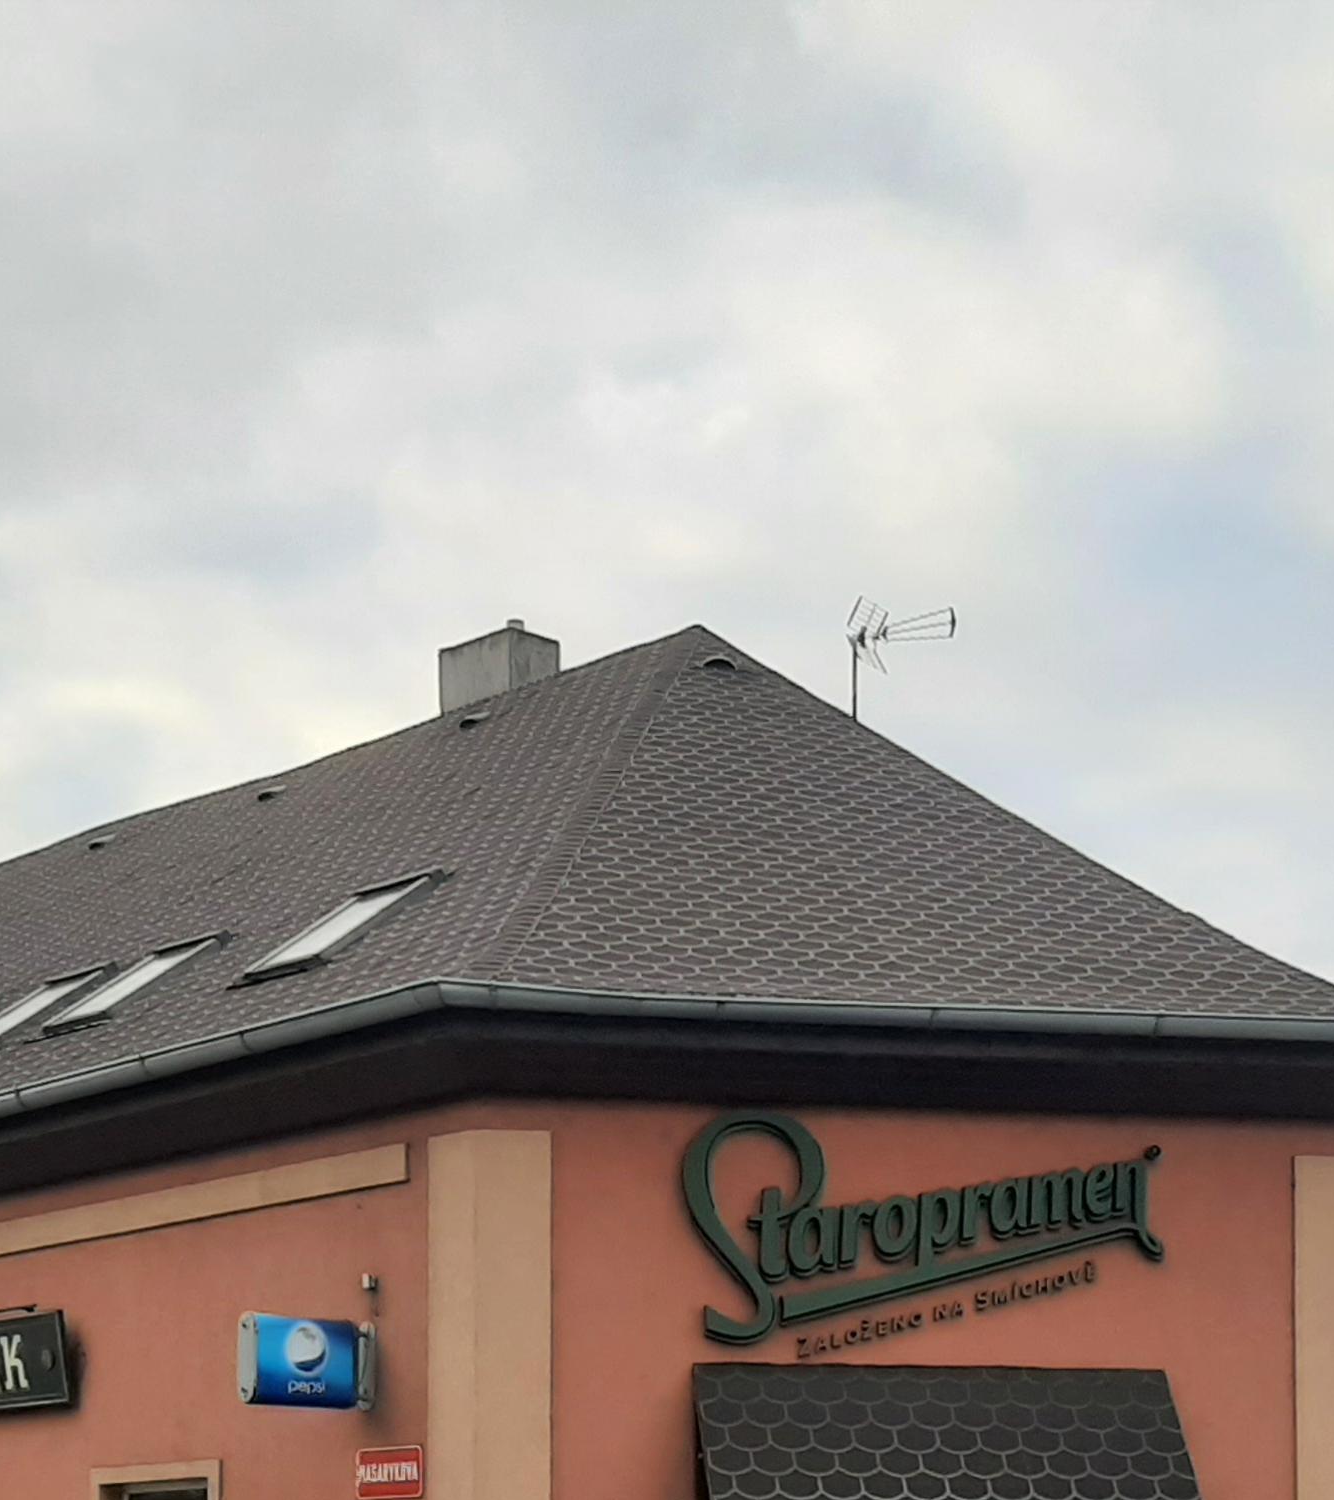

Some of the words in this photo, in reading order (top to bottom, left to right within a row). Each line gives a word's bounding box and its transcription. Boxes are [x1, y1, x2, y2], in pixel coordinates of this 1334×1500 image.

[682, 1110, 1163, 1346] Staropramen
[796, 1311, 923, 1359] ZALOŽENO
[932, 1301, 965, 1323] NA
[287, 1380, 326, 1395] pepsi
